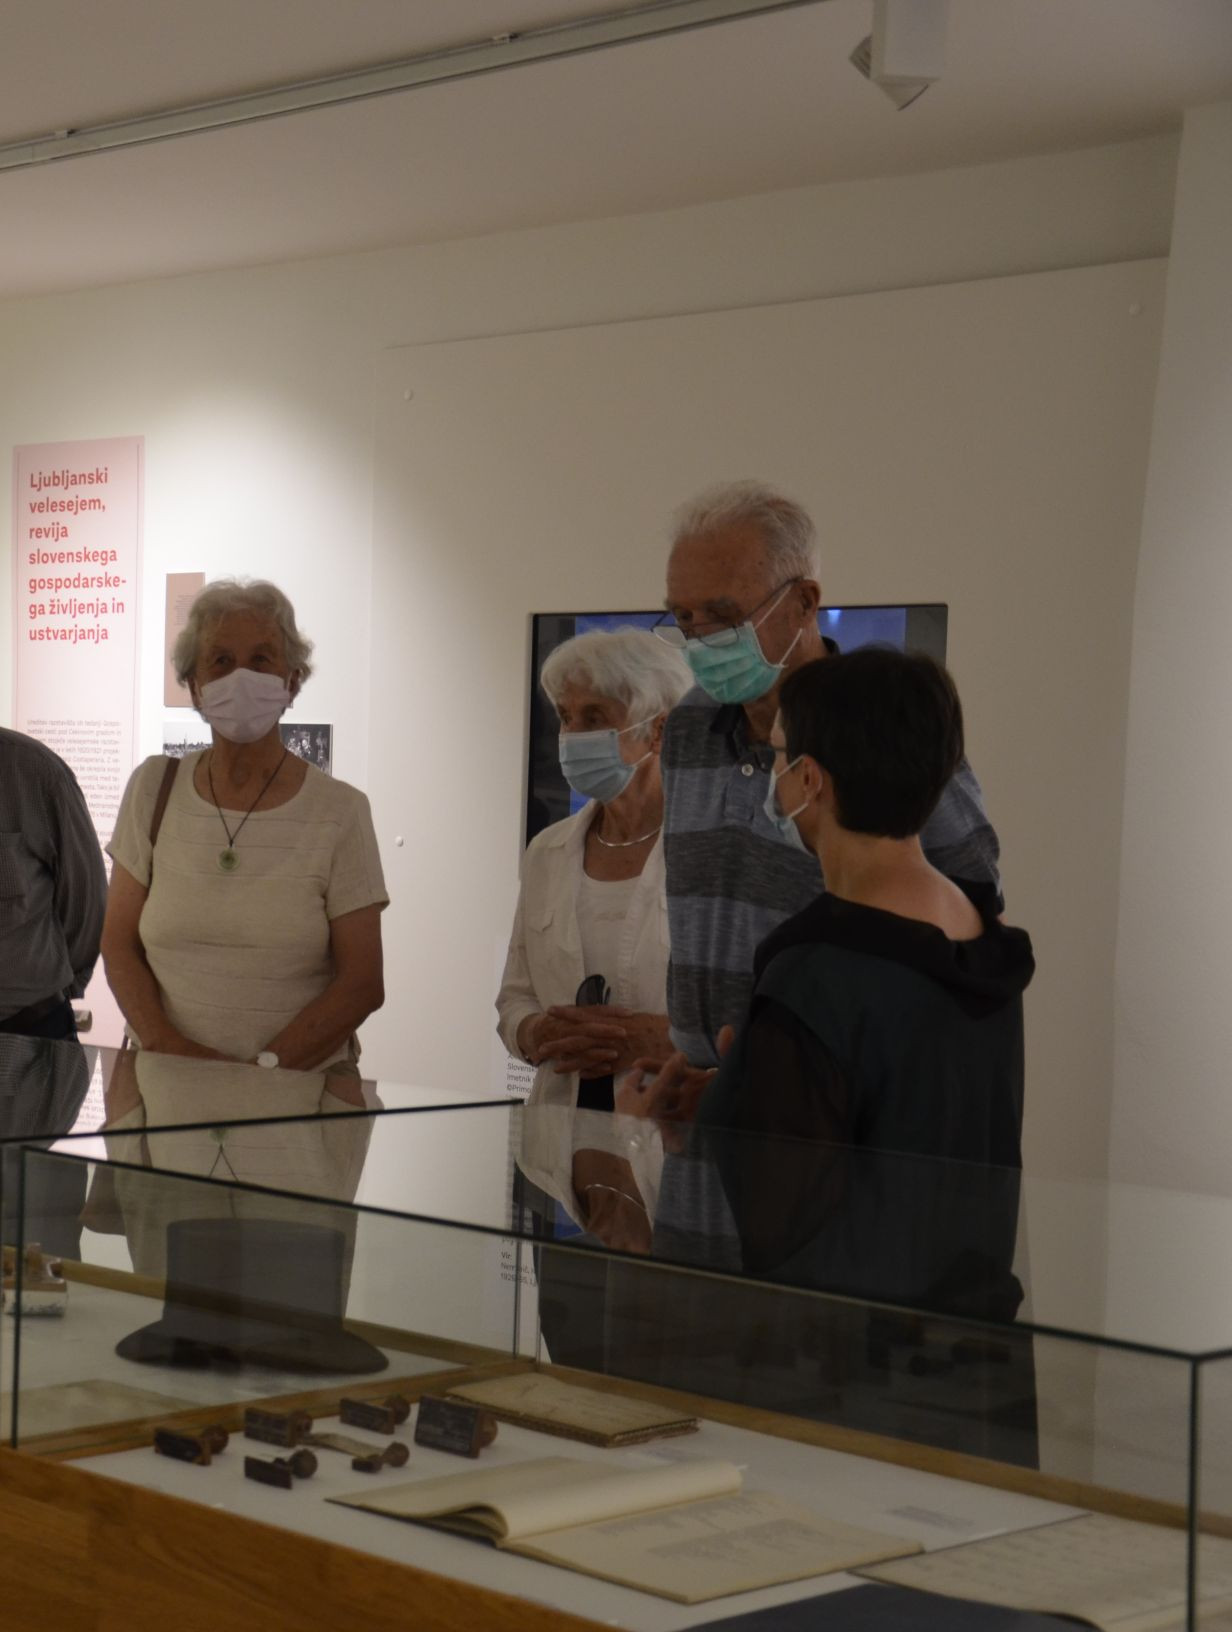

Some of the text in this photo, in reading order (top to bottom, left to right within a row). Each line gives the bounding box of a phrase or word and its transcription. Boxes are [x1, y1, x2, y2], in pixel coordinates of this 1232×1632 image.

[30, 467, 109, 492] Ljubljanski
[29, 495, 106, 515] velesejem,
[29, 522, 68, 542] revija
[29, 547, 117, 566] slovenskega
[29, 572, 126, 593] gospodarske-
[29, 597, 125, 619] ga življenja in
[29, 624, 109, 644] ustvarjanja
